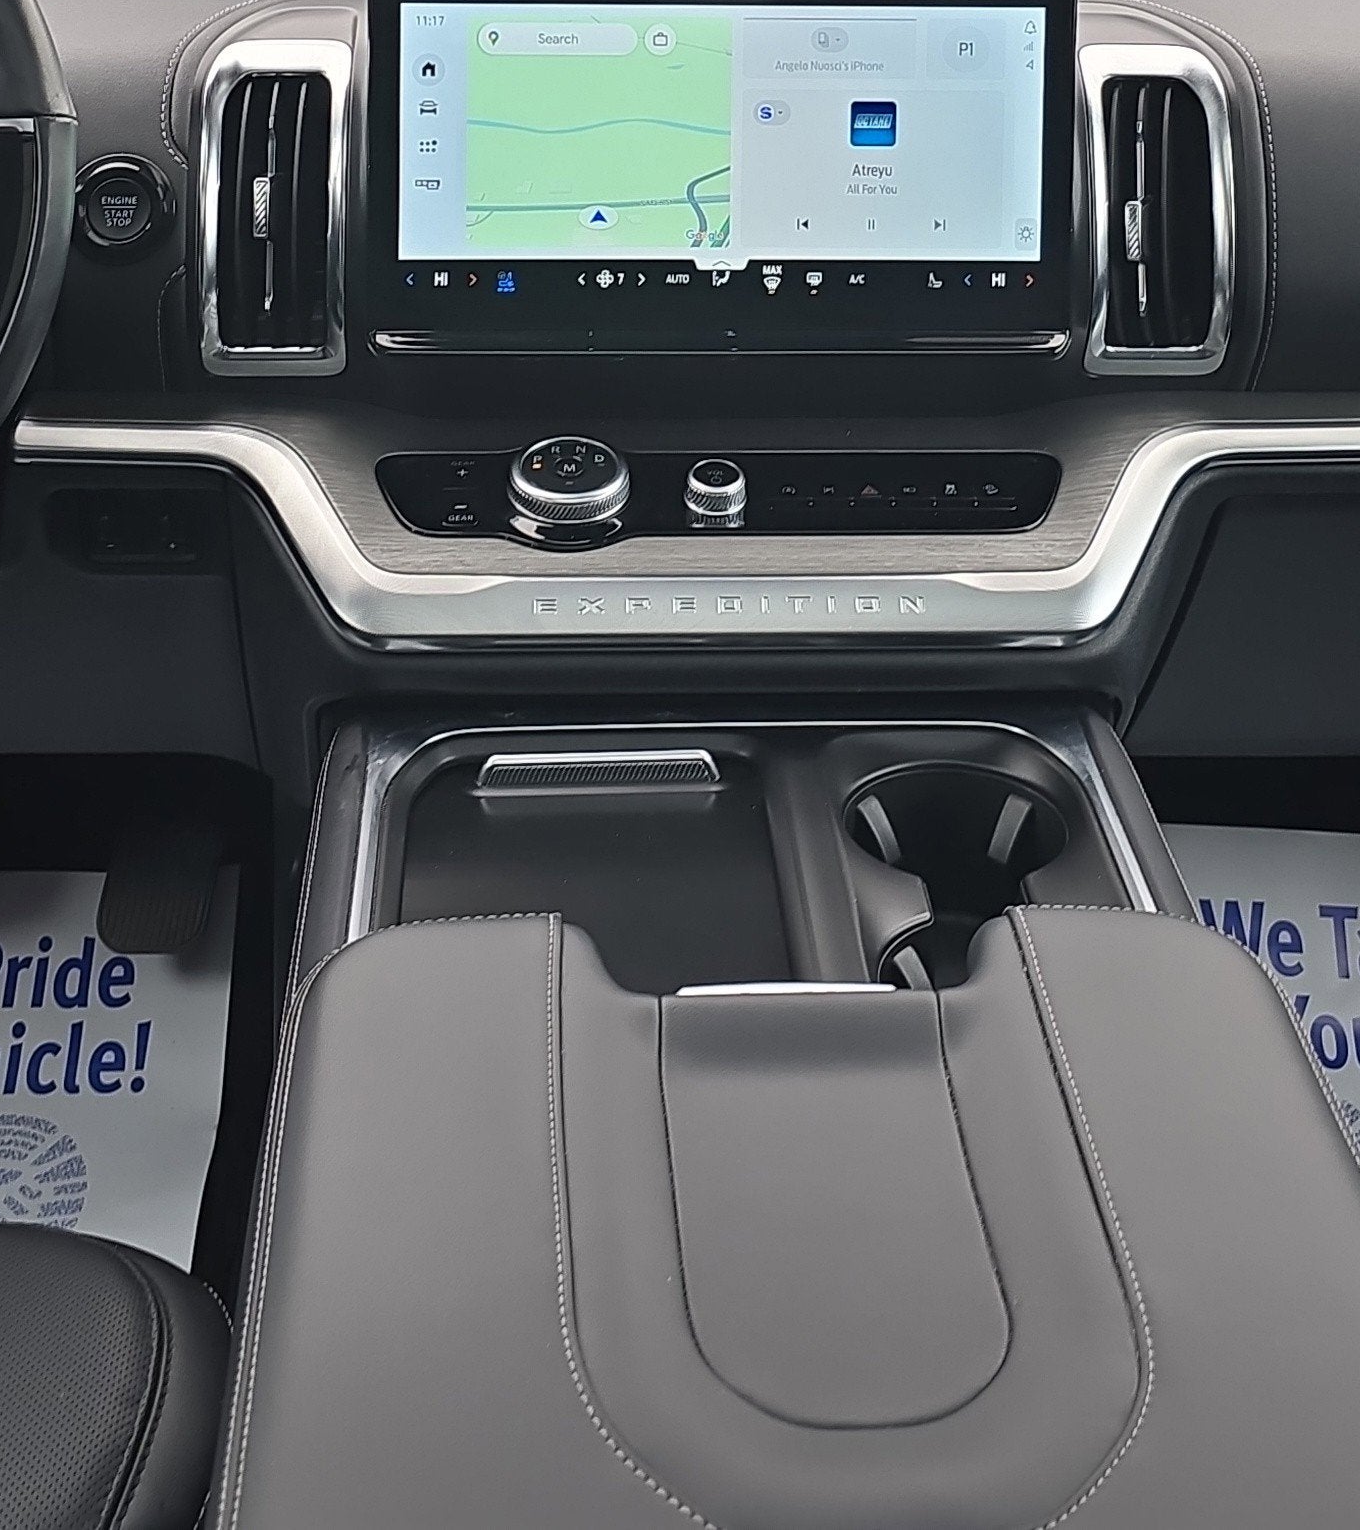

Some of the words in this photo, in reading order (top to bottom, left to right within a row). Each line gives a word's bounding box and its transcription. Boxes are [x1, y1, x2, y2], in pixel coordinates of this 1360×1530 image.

[416, 15, 445, 27] 11:17
[537, 32, 579, 45] Search
[958, 42, 975, 57] P1
[775, 60, 808, 72] Angelo
[850, 60, 885, 72] iPhone
[851, 163, 893, 179] Atreyu
[846, 183, 860, 195] All
[862, 183, 879, 195] For
[880, 183, 898, 195] You
[101, 195, 138, 205] ENGINE
[104, 209, 135, 218] START
[106, 218, 132, 227] STOP
[762, 265, 782, 275] MAX
[433, 272, 449, 287] HI
[617, 273, 625, 285] 7
[665, 273, 690, 285] AUTO
[848, 273, 865, 285] A/C
[991, 273, 1006, 288] HI
[551, 445, 561, 455] R
[575, 444, 587, 454] N
[533, 455, 541, 465] P
[594, 454, 605, 463] D
[563, 463, 576, 472] M
[448, 514, 474, 522] GEAR
[532, 594, 927, 617] EXPEDITION
[1197, 898, 1304, 977] We
